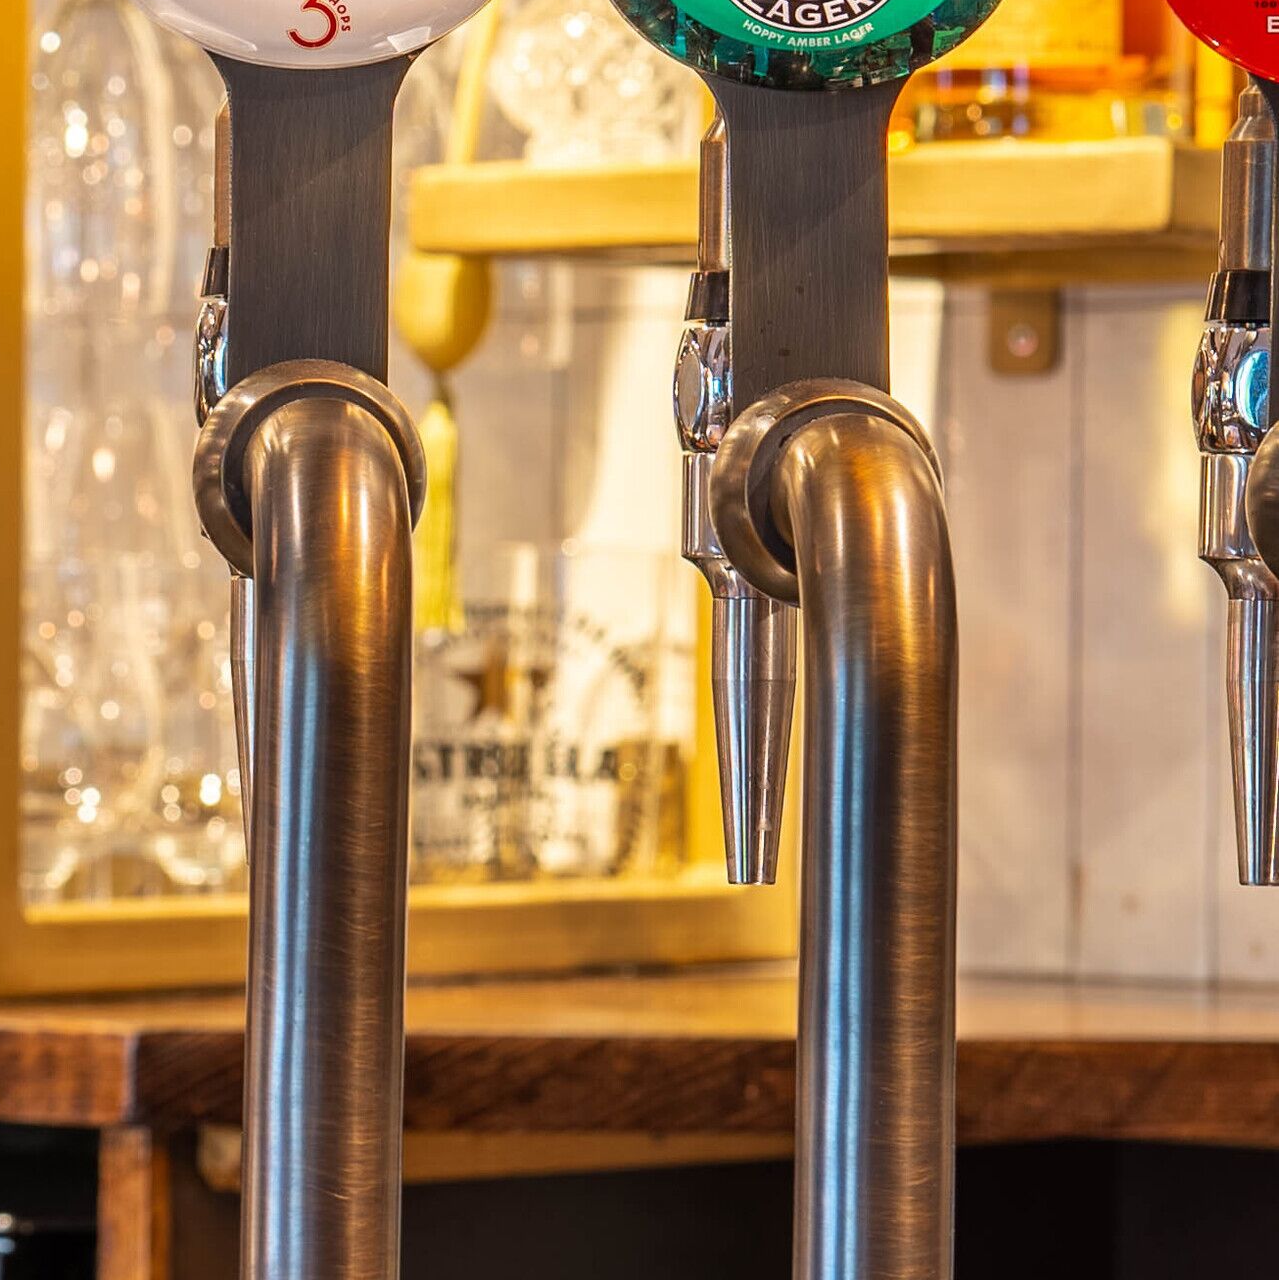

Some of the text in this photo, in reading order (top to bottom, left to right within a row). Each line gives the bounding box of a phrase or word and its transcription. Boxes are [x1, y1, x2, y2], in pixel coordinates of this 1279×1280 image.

[743, 20, 874, 48] HOPPY AMBER LAGER
